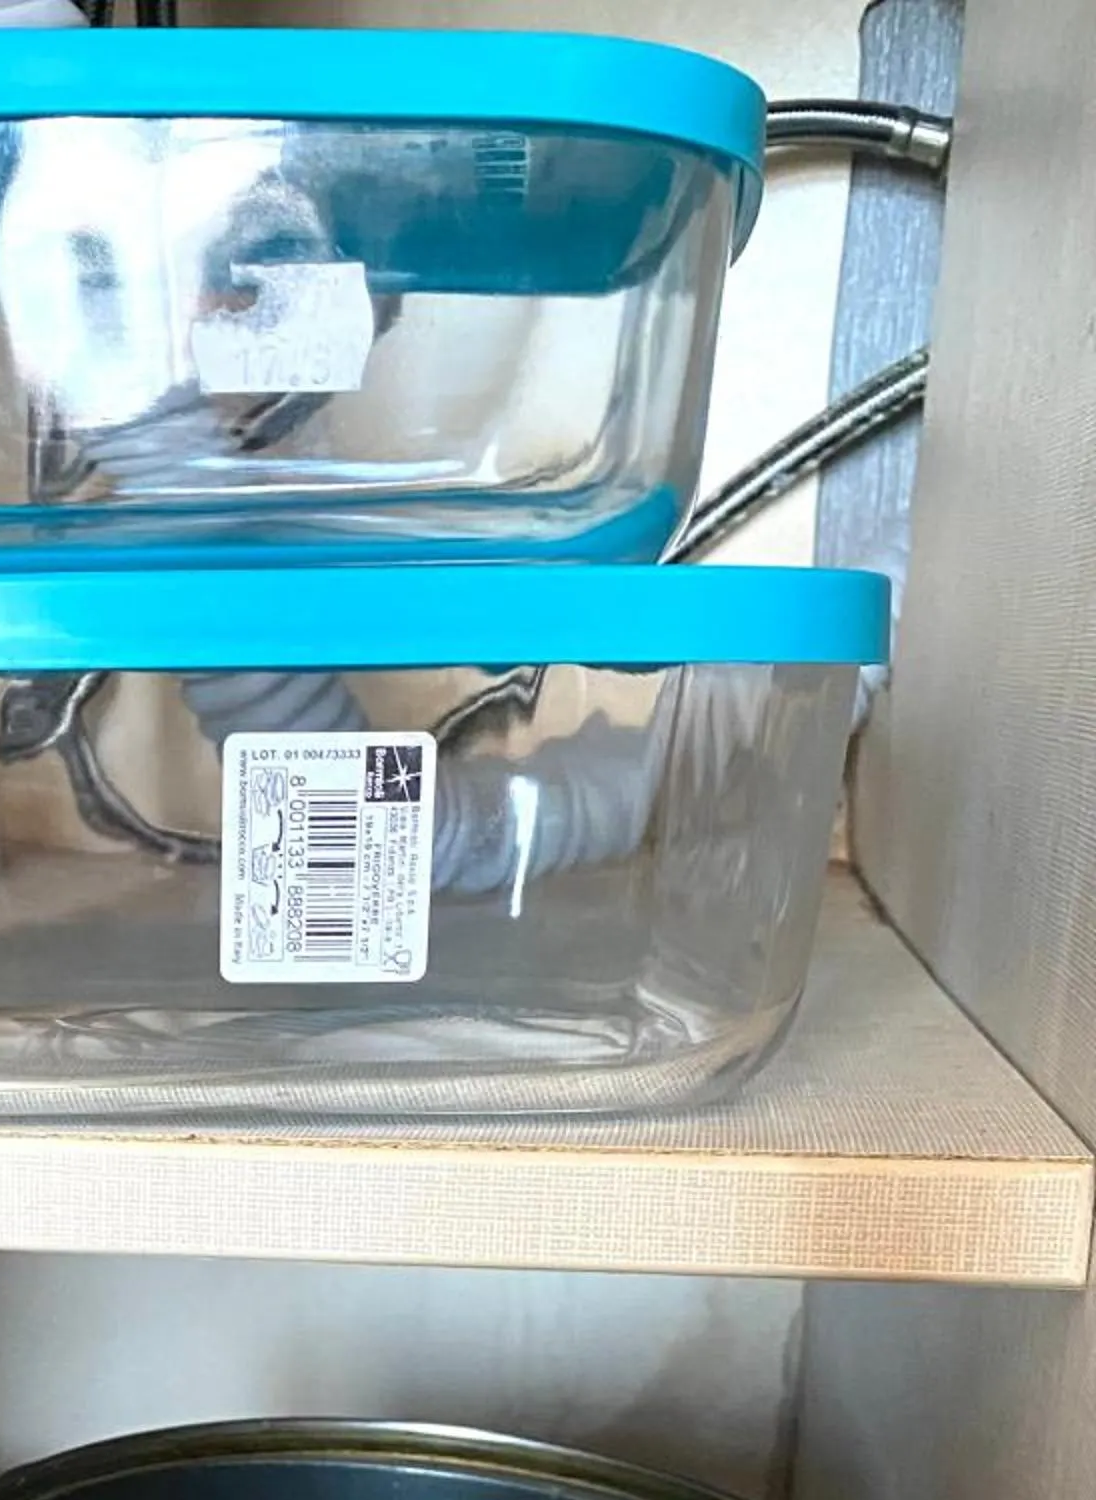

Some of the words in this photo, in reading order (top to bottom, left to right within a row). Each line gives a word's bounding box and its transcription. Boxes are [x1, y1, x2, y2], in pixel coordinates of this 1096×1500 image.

[289, 776, 306, 788] 8
[375, 748, 386, 799] Bormioli
[287, 800, 306, 869] 001133
[234, 893, 245, 924] Made
[286, 885, 303, 953] 888208
